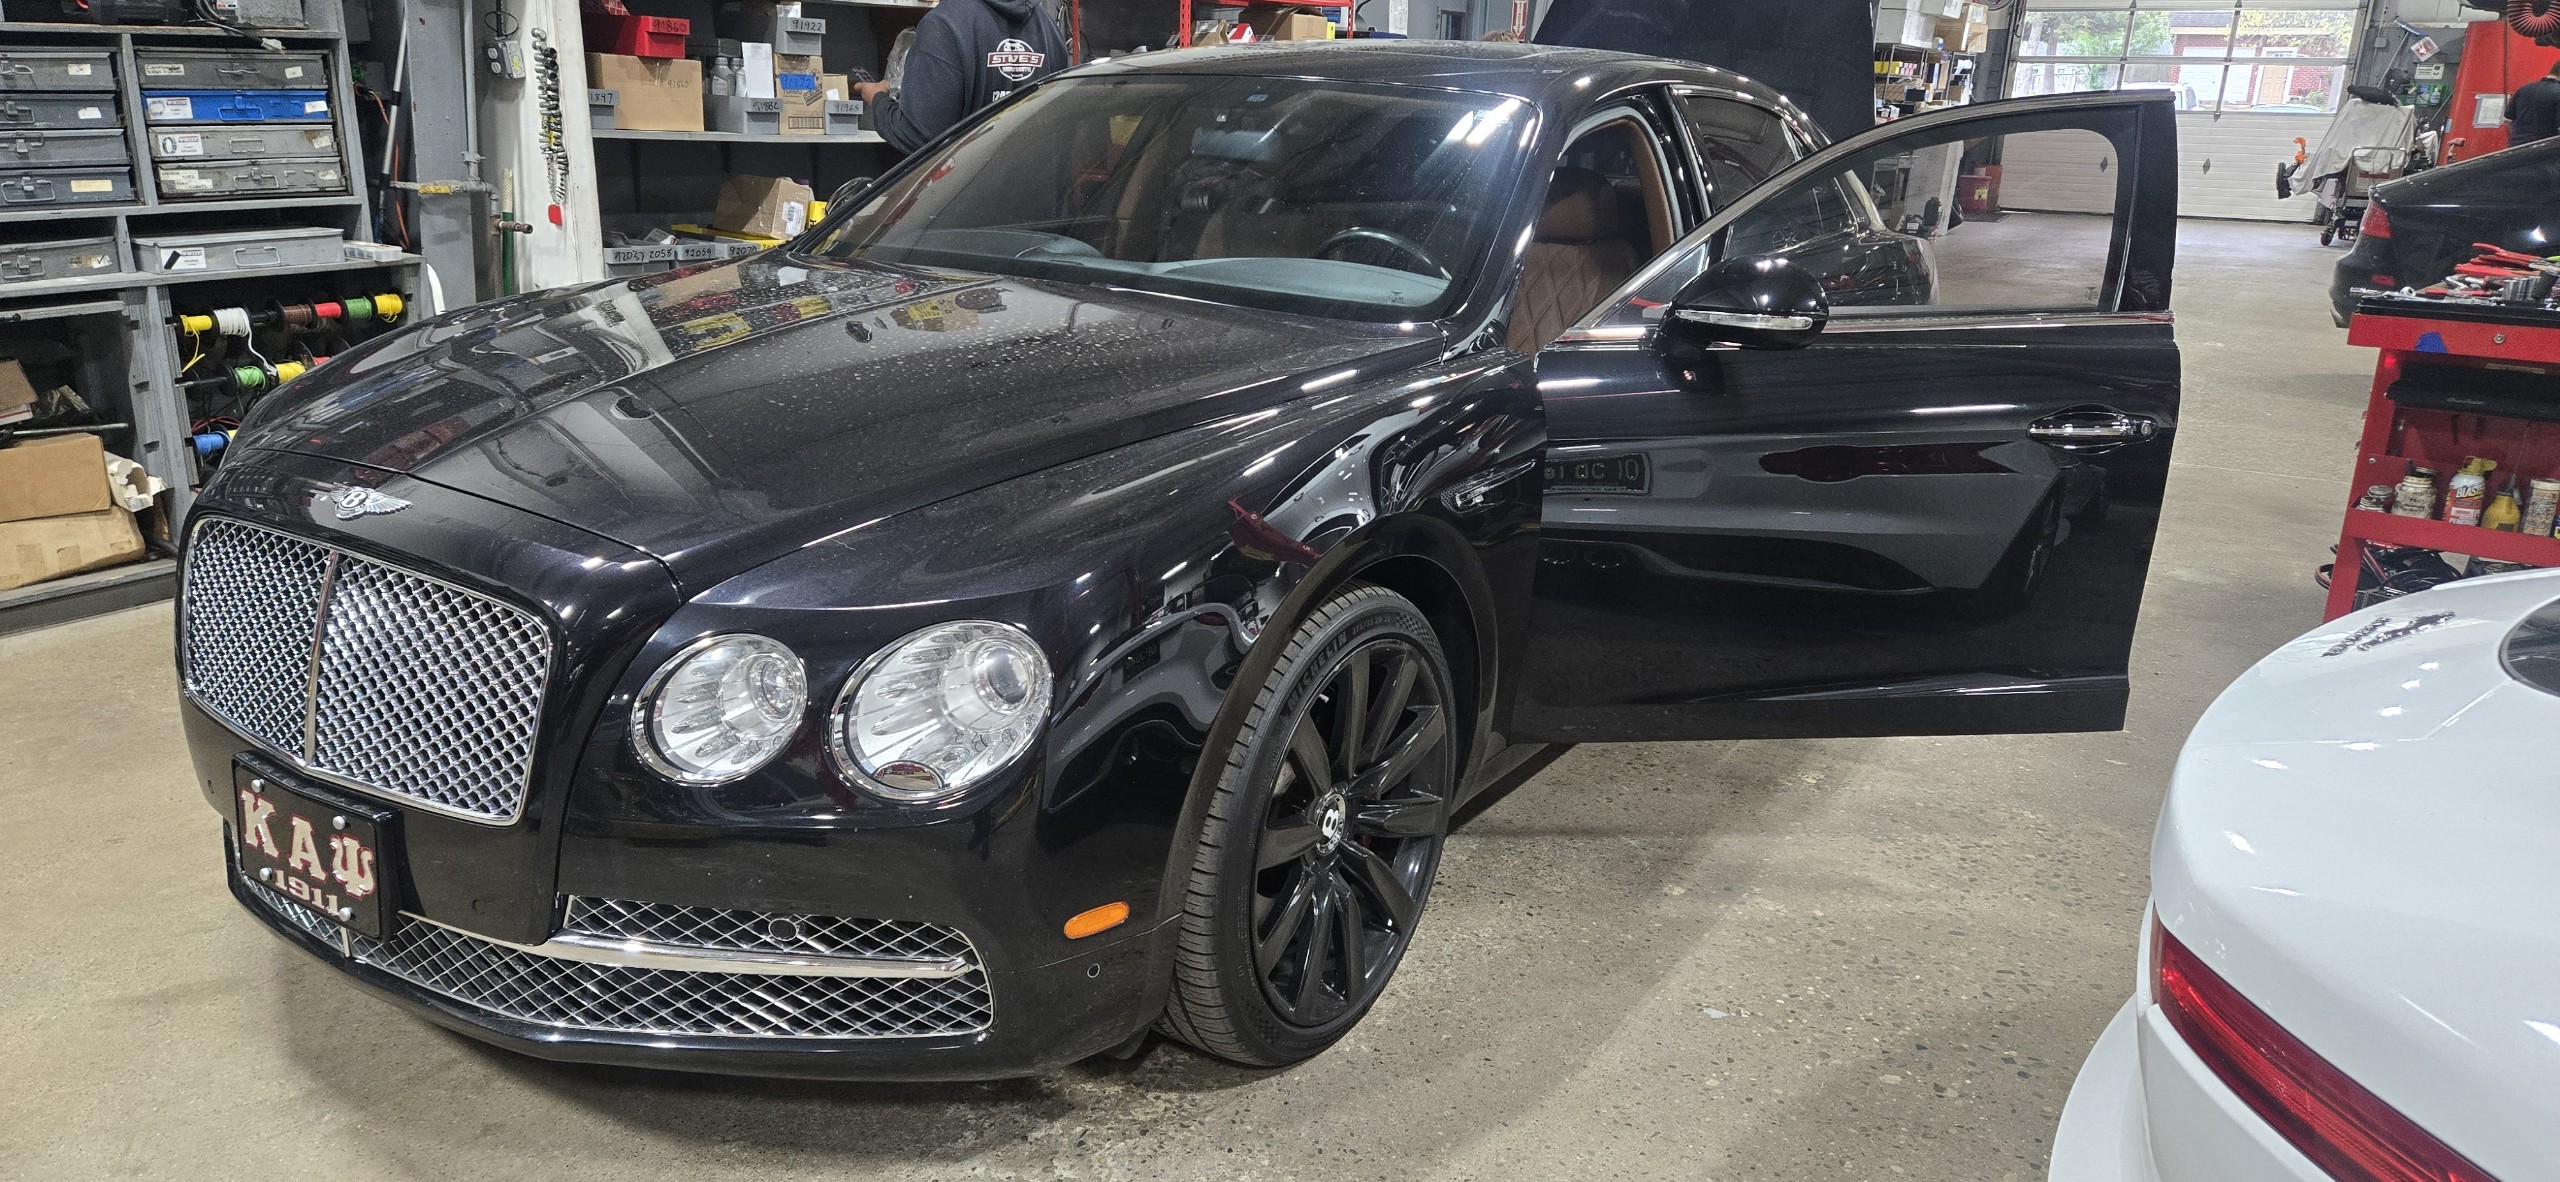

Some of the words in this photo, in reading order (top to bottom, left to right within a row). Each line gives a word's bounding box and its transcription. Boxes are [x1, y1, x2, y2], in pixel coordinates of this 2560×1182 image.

[653, 20, 687, 32] 91860
[792, 20, 822, 31] 91922
[1287, 631, 1347, 711] MICHELIN
[274, 869, 340, 917] 1911
